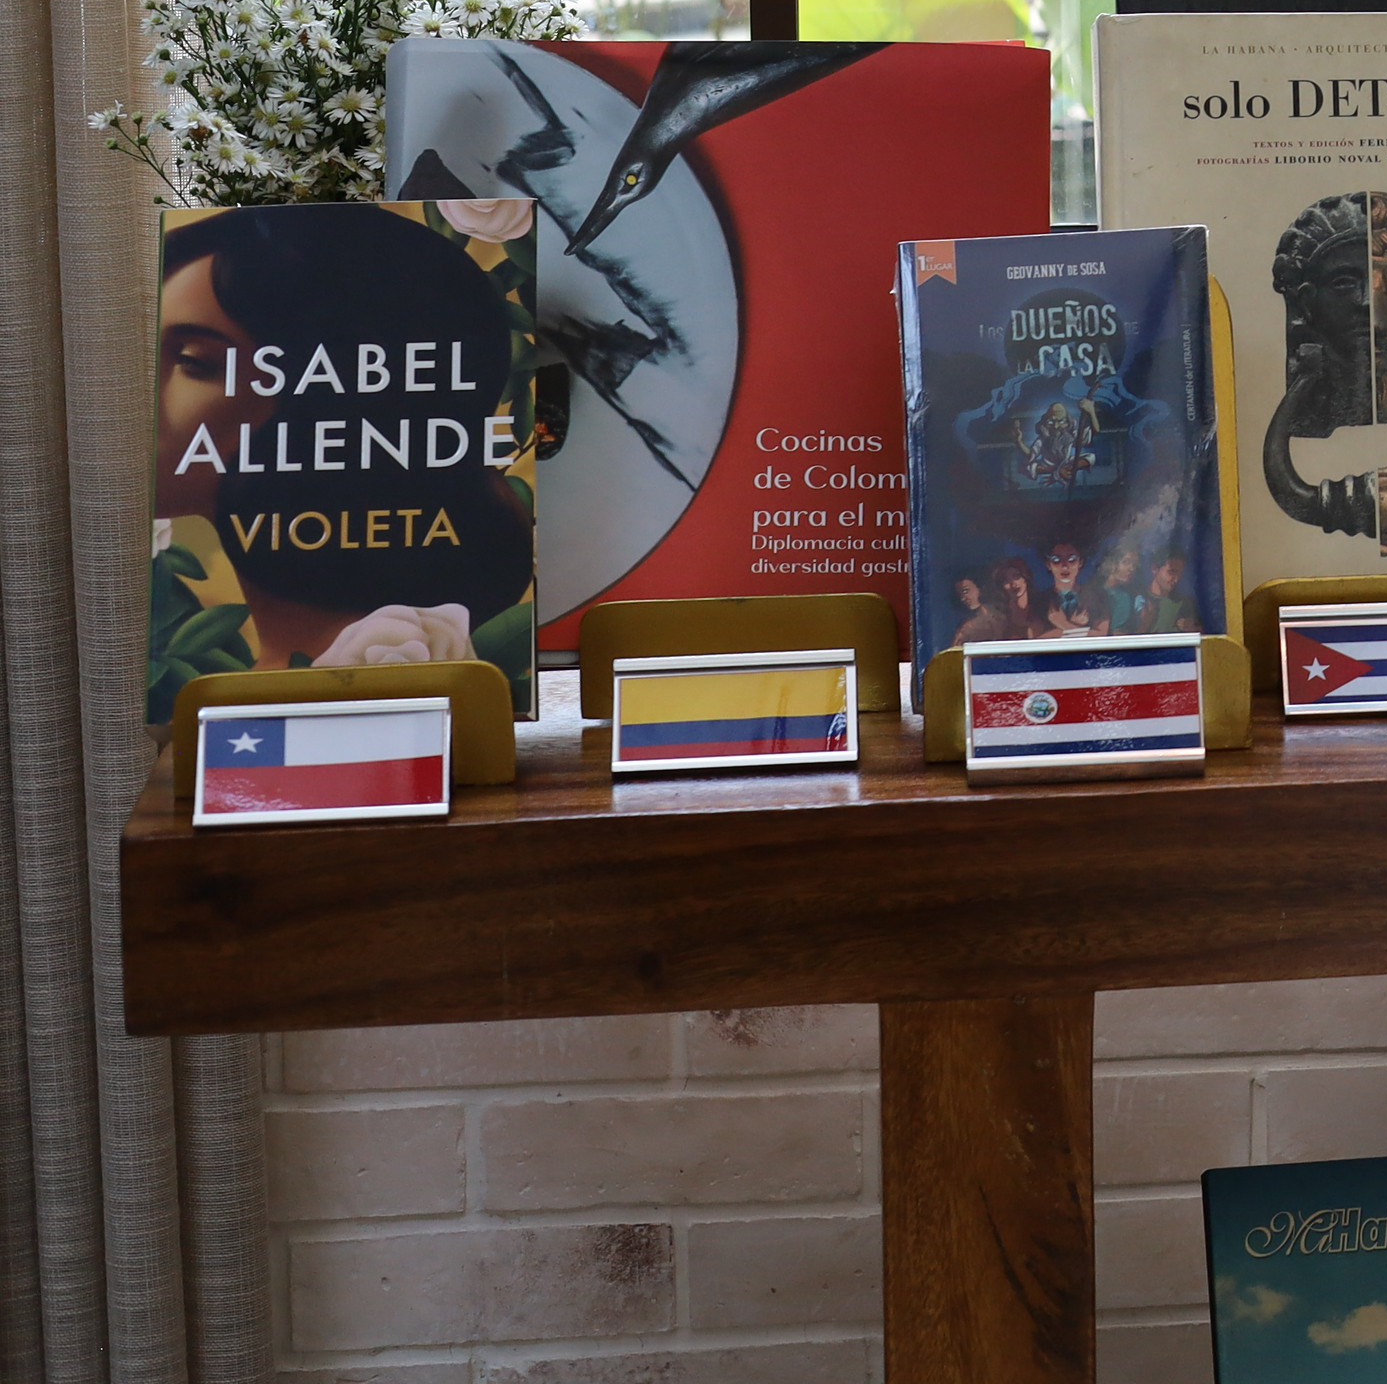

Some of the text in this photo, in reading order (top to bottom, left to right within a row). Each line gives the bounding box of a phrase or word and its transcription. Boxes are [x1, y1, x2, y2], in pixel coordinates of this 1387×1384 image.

[1202, 45, 1220, 55] LA
[1227, 44, 1287, 55] HABANA
[1183, 80, 1270, 120] solo
[1253, 140, 1293, 149] TEXTOS
[1298, 140, 1305, 148] Y
[1309, 138, 1354, 148] EDICIÓN
[1197, 155, 1270, 165] FOTOGRAFÍAS
[1275, 154, 1332, 164] LIBORIO
[1338, 153, 1382, 164] NOVAL
[1007, 262, 1106, 279] GEOVANNY DE SOSA
[1010, 300, 1117, 341] DUEÑOS
[225, 341, 476, 397] ISABEL
[1038, 342, 1117, 377] CASA
[1185, 370, 1194, 381] de
[1185, 380, 1196, 421] CERTAMEN
[174, 416, 516, 475] ALLENDE
[755, 428, 882, 452] Cocinas
[753, 466, 791, 489] de
[752, 503, 864, 532] para el
[230, 507, 461, 553] VIOLETA
[752, 534, 865, 553] Diplomacia
[751, 558, 855, 573] diversidad
